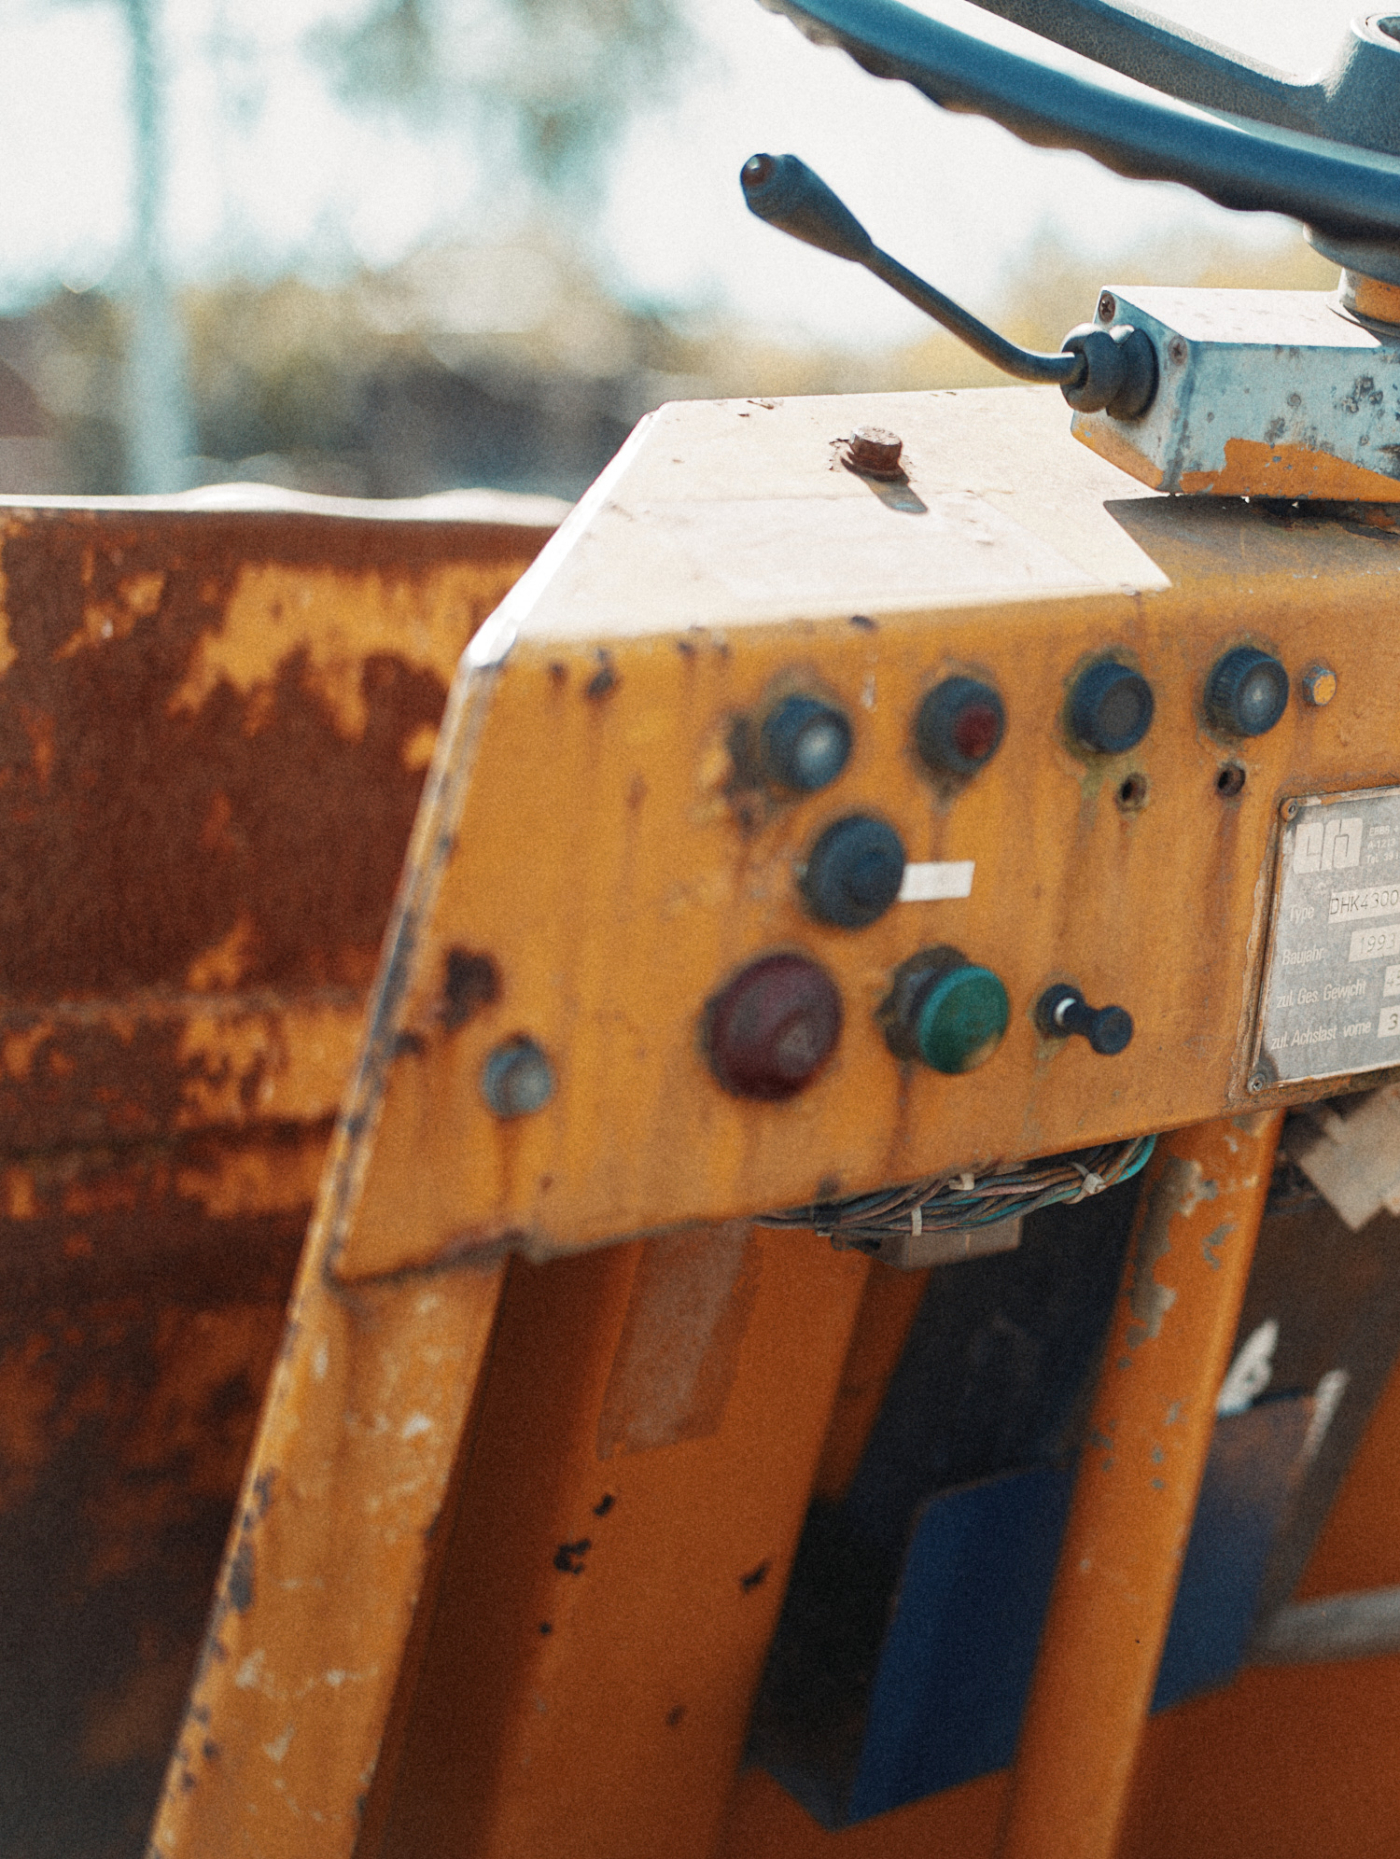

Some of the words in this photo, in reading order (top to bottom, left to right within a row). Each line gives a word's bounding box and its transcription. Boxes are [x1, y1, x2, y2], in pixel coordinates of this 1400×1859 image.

[1289, 904, 1315, 924] Type
[1282, 944, 1325, 967] Baujahr
[1360, 932, 1397, 954] 1993
[1323, 978, 1367, 1002] Gewicht
[1290, 1025, 1337, 1047] Achslast
[1343, 1020, 1372, 1038] vorne
